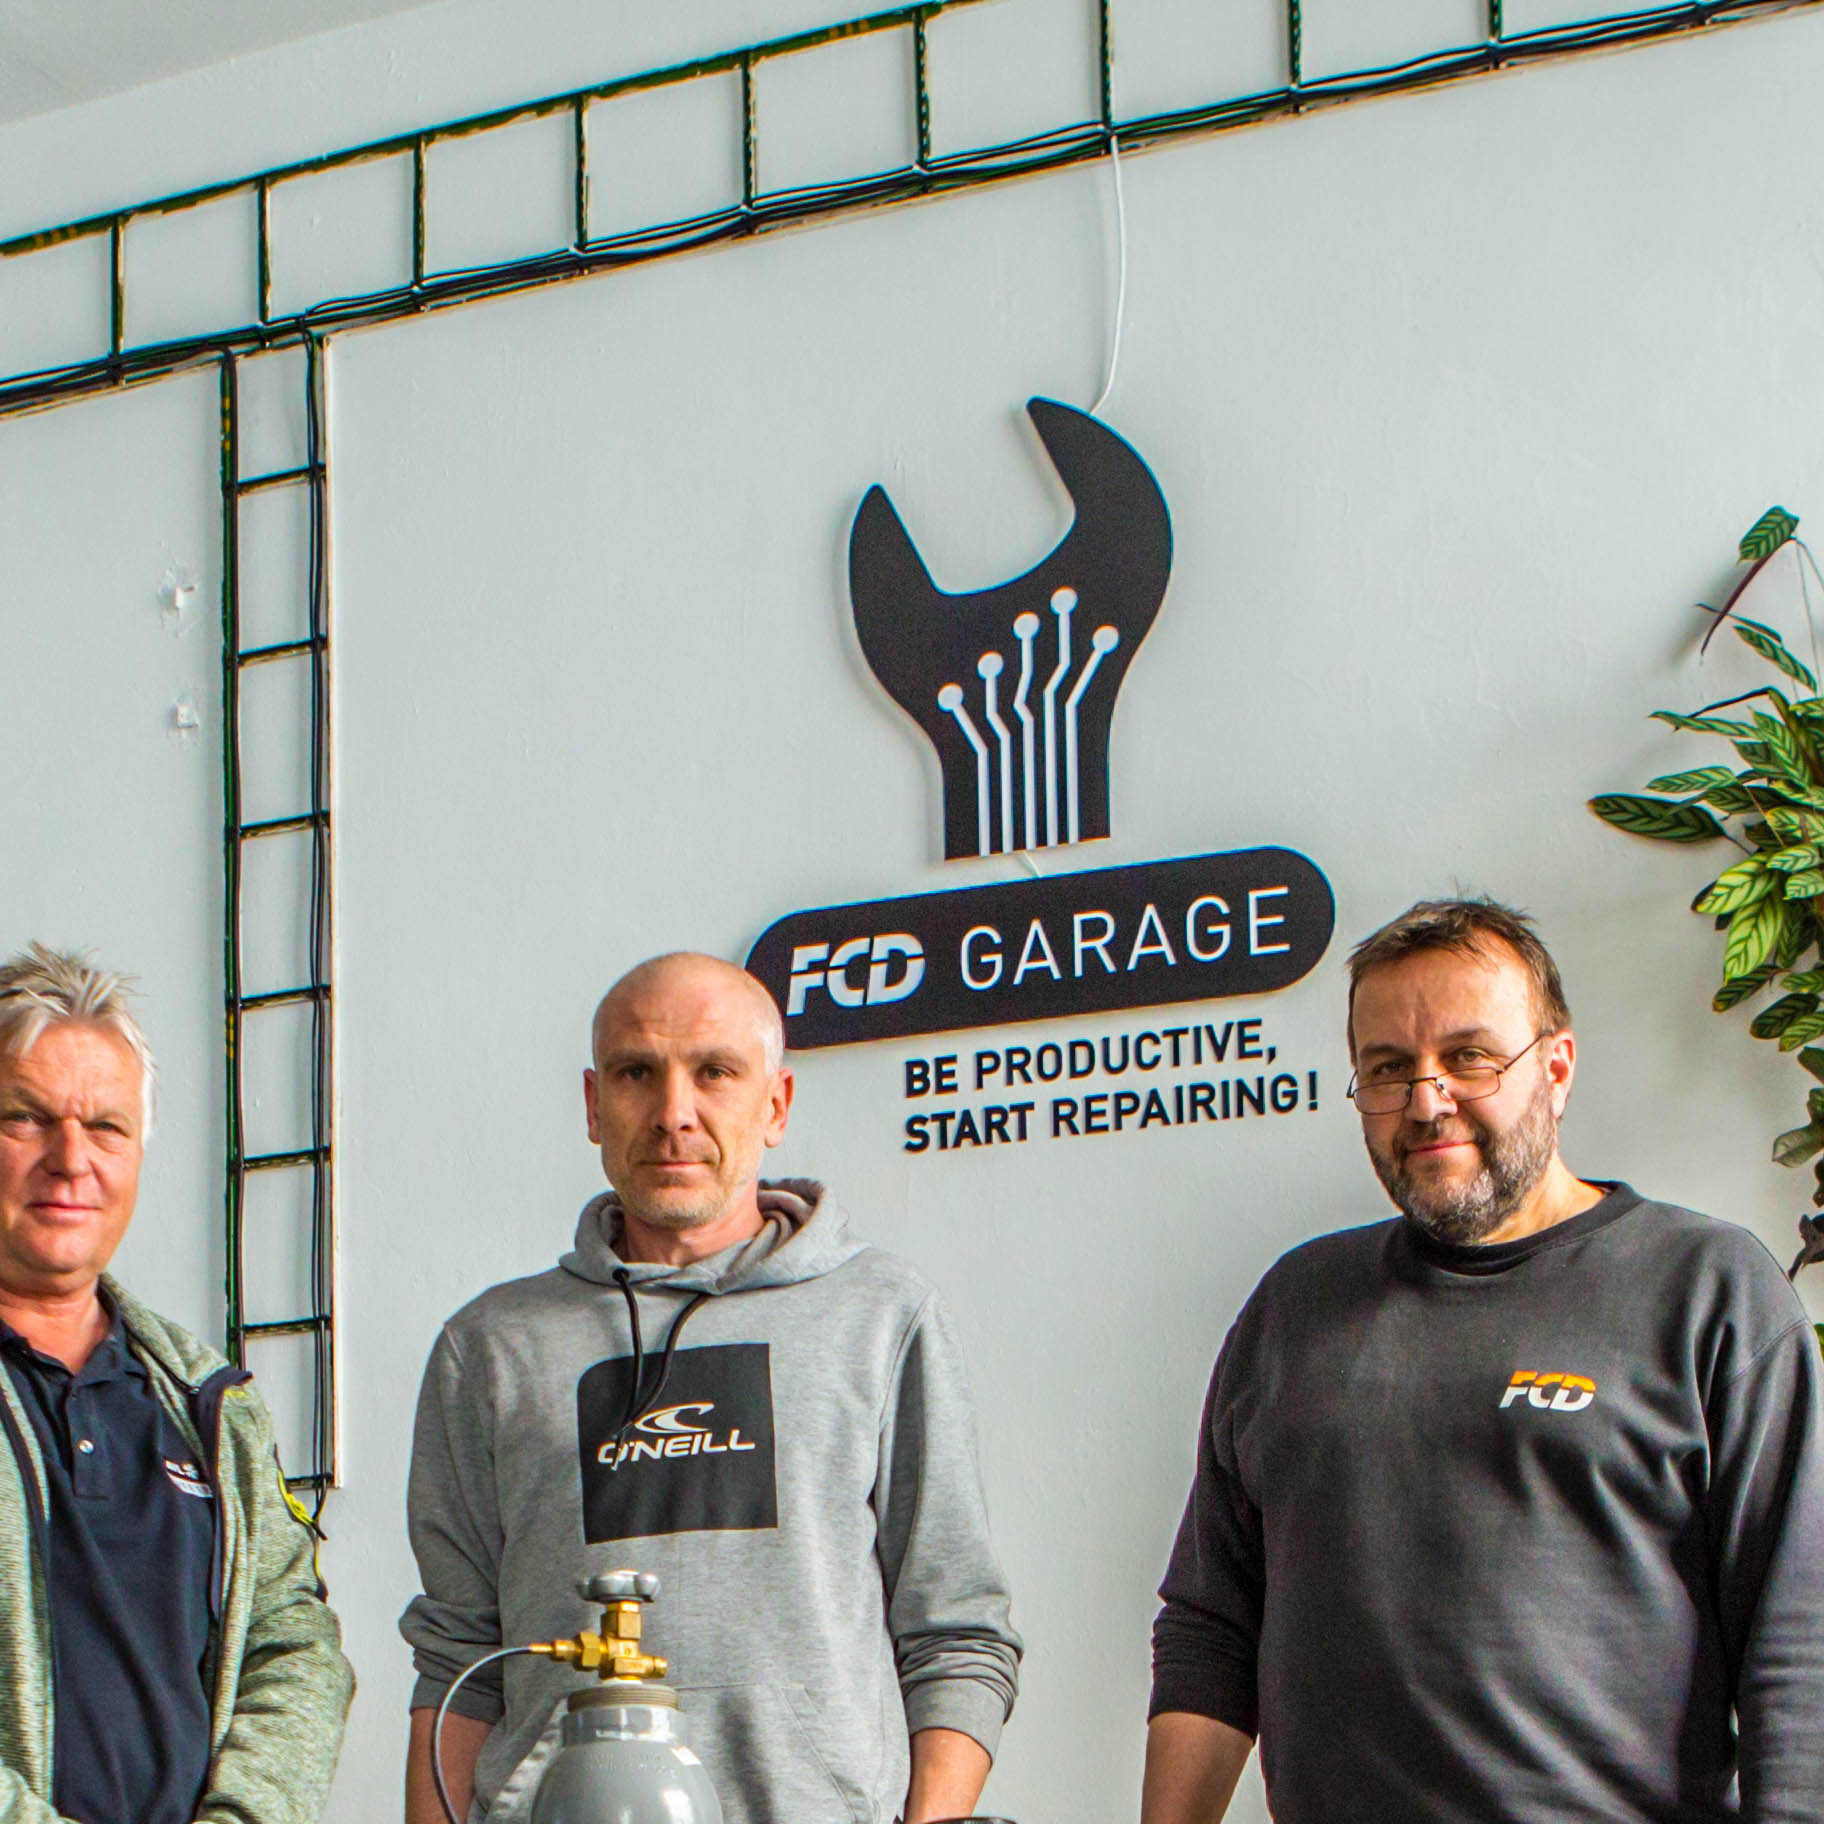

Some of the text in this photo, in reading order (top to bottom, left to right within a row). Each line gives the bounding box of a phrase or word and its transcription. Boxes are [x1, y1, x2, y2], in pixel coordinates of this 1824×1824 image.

[786, 886, 1290, 1016] FCD GARAGE
[905, 1019, 1277, 1098] BE PRODUCTIVE,
[904, 1071, 1318, 1154] START REPAIRING!
[1499, 1370, 1597, 1412] FCD
[598, 1429, 756, 1464] O'NEILL
